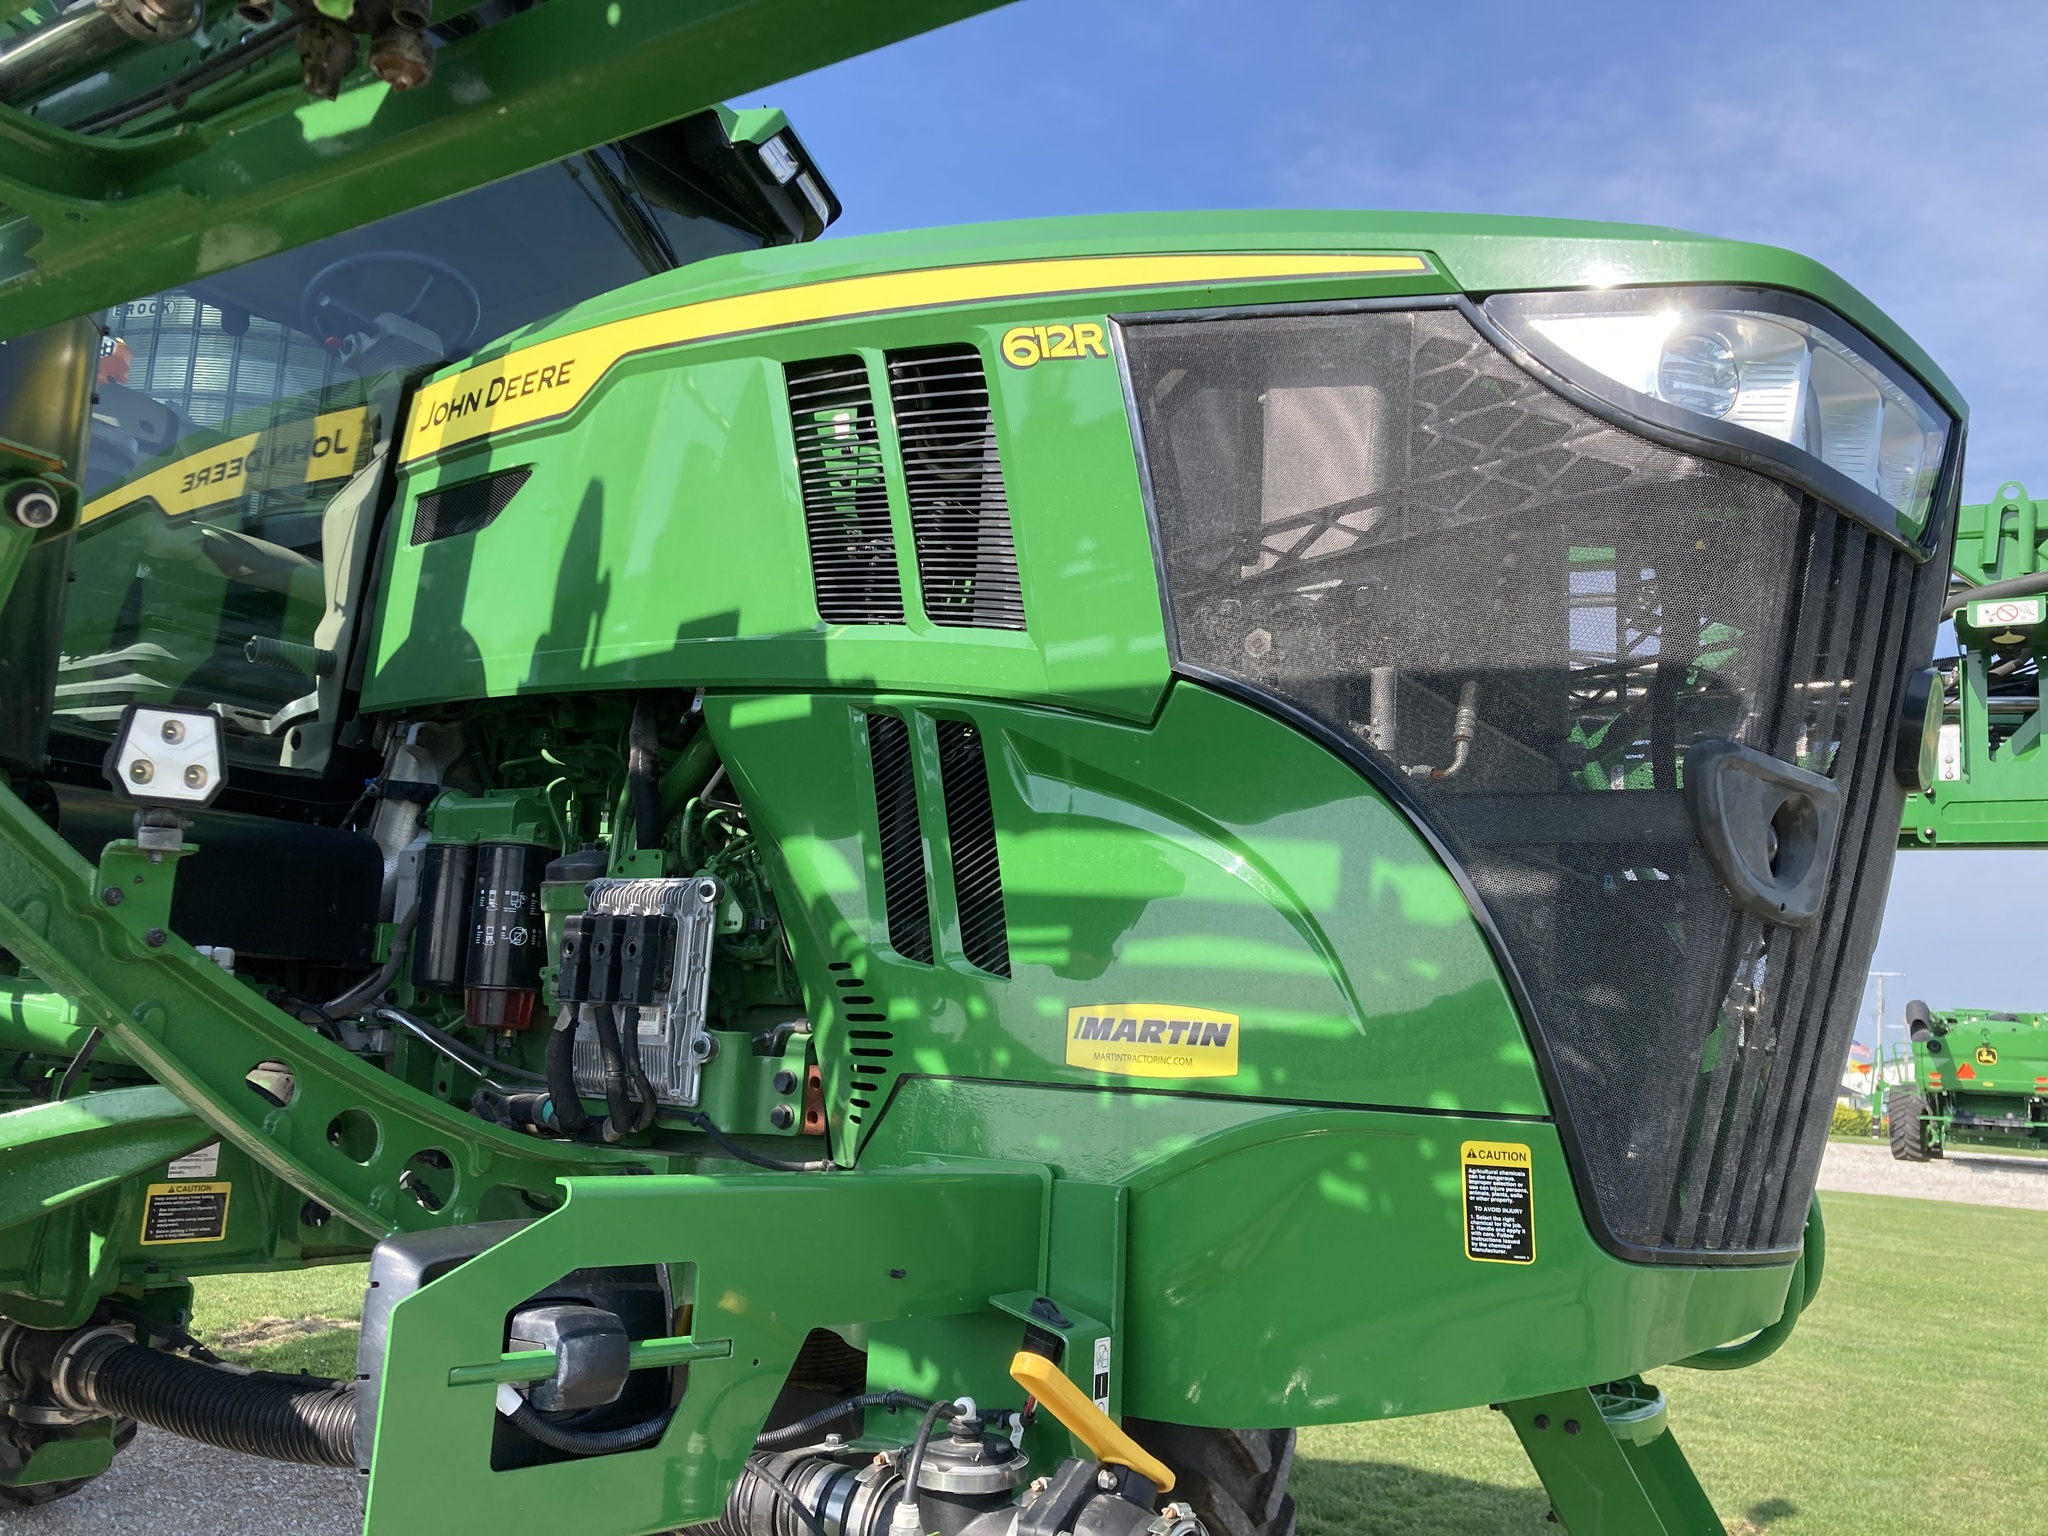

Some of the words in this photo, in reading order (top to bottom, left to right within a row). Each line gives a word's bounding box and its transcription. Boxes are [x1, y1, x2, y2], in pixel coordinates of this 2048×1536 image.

[1000, 323, 1108, 370] 612R
[420, 389, 482, 433] JOHN
[485, 359, 575, 408] DEERE
[1093, 1052, 1193, 1066] MARTINTRACTORINC.COM
[1478, 1149, 1527, 1162] CAUTION
[176, 1185, 213, 1193] CAUTION
